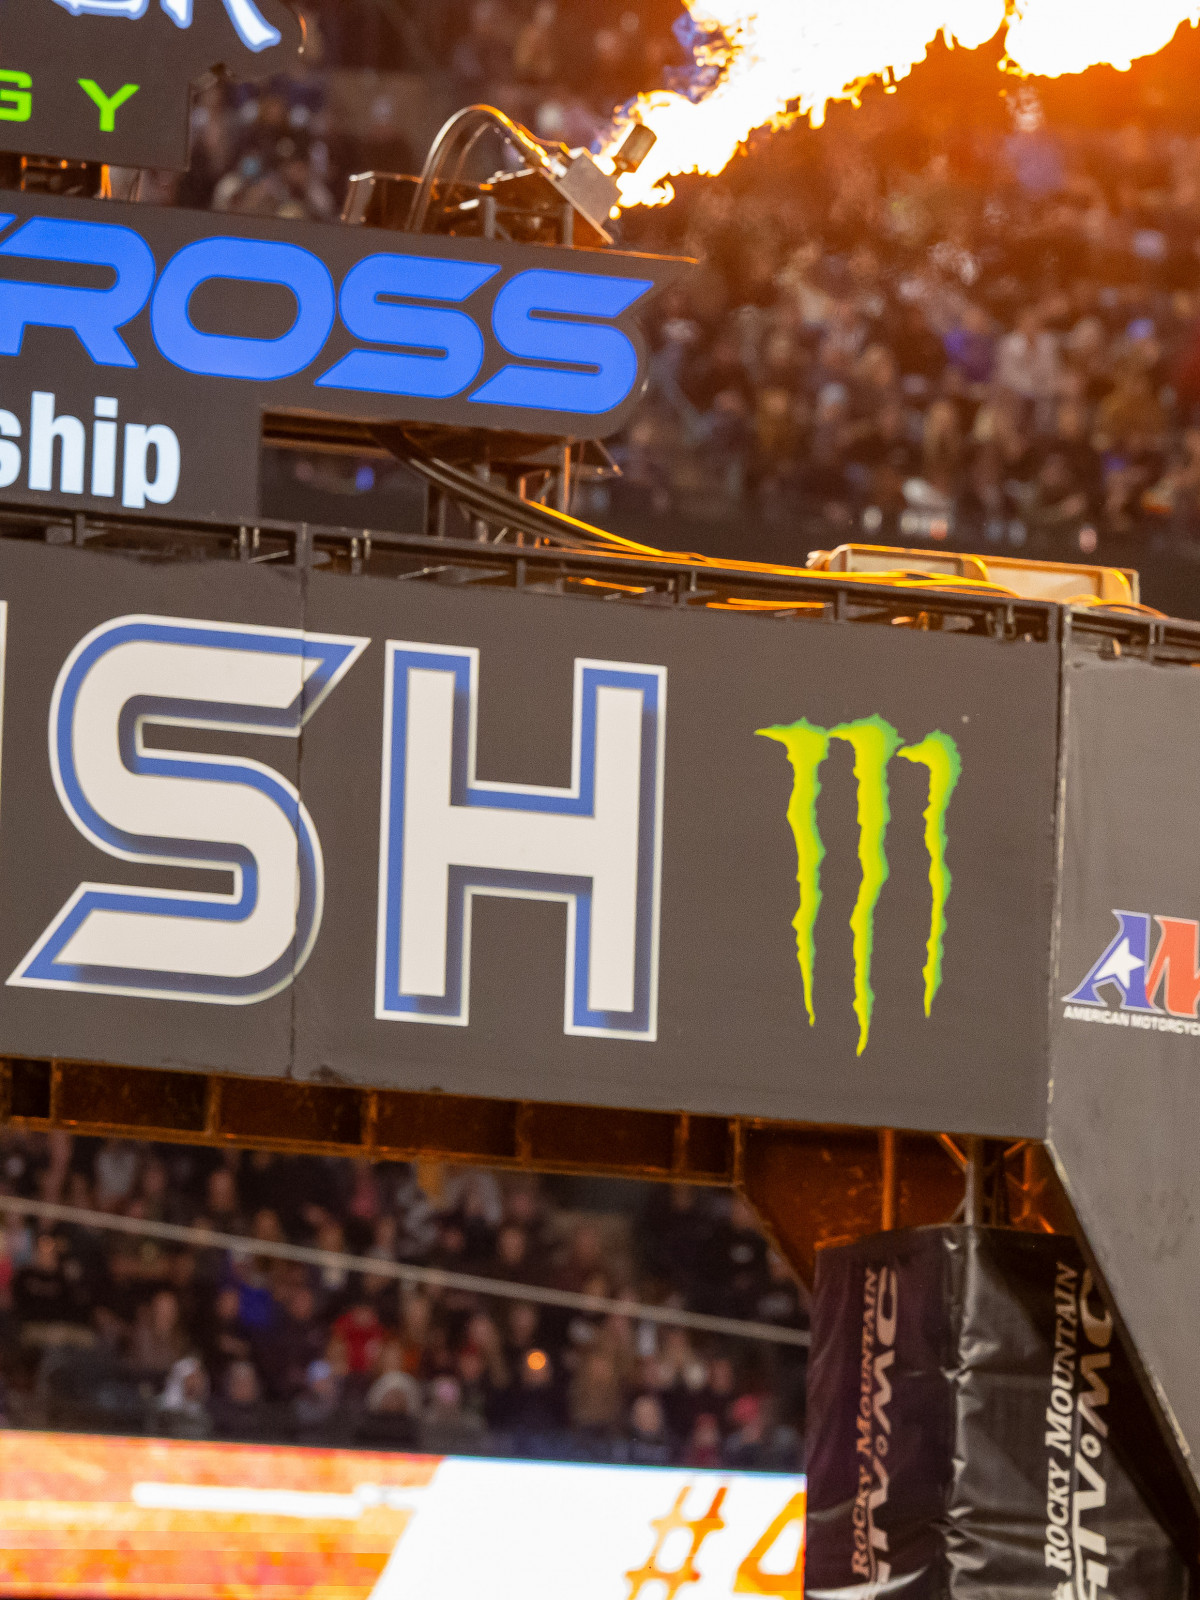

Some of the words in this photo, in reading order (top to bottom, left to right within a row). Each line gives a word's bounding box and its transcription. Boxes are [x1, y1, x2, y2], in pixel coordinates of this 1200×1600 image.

[0, 213, 656, 416] ROSS
[0, 606, 668, 1043] SH
[1063, 1005, 1132, 1027] AMERICAN
[855, 1267, 879, 1458] MOUNTAIN
[1044, 1259, 1080, 1457] MOUNTAIN
[850, 1467, 874, 1577] ROCKY
[1044, 1457, 1072, 1576] ROCKY
